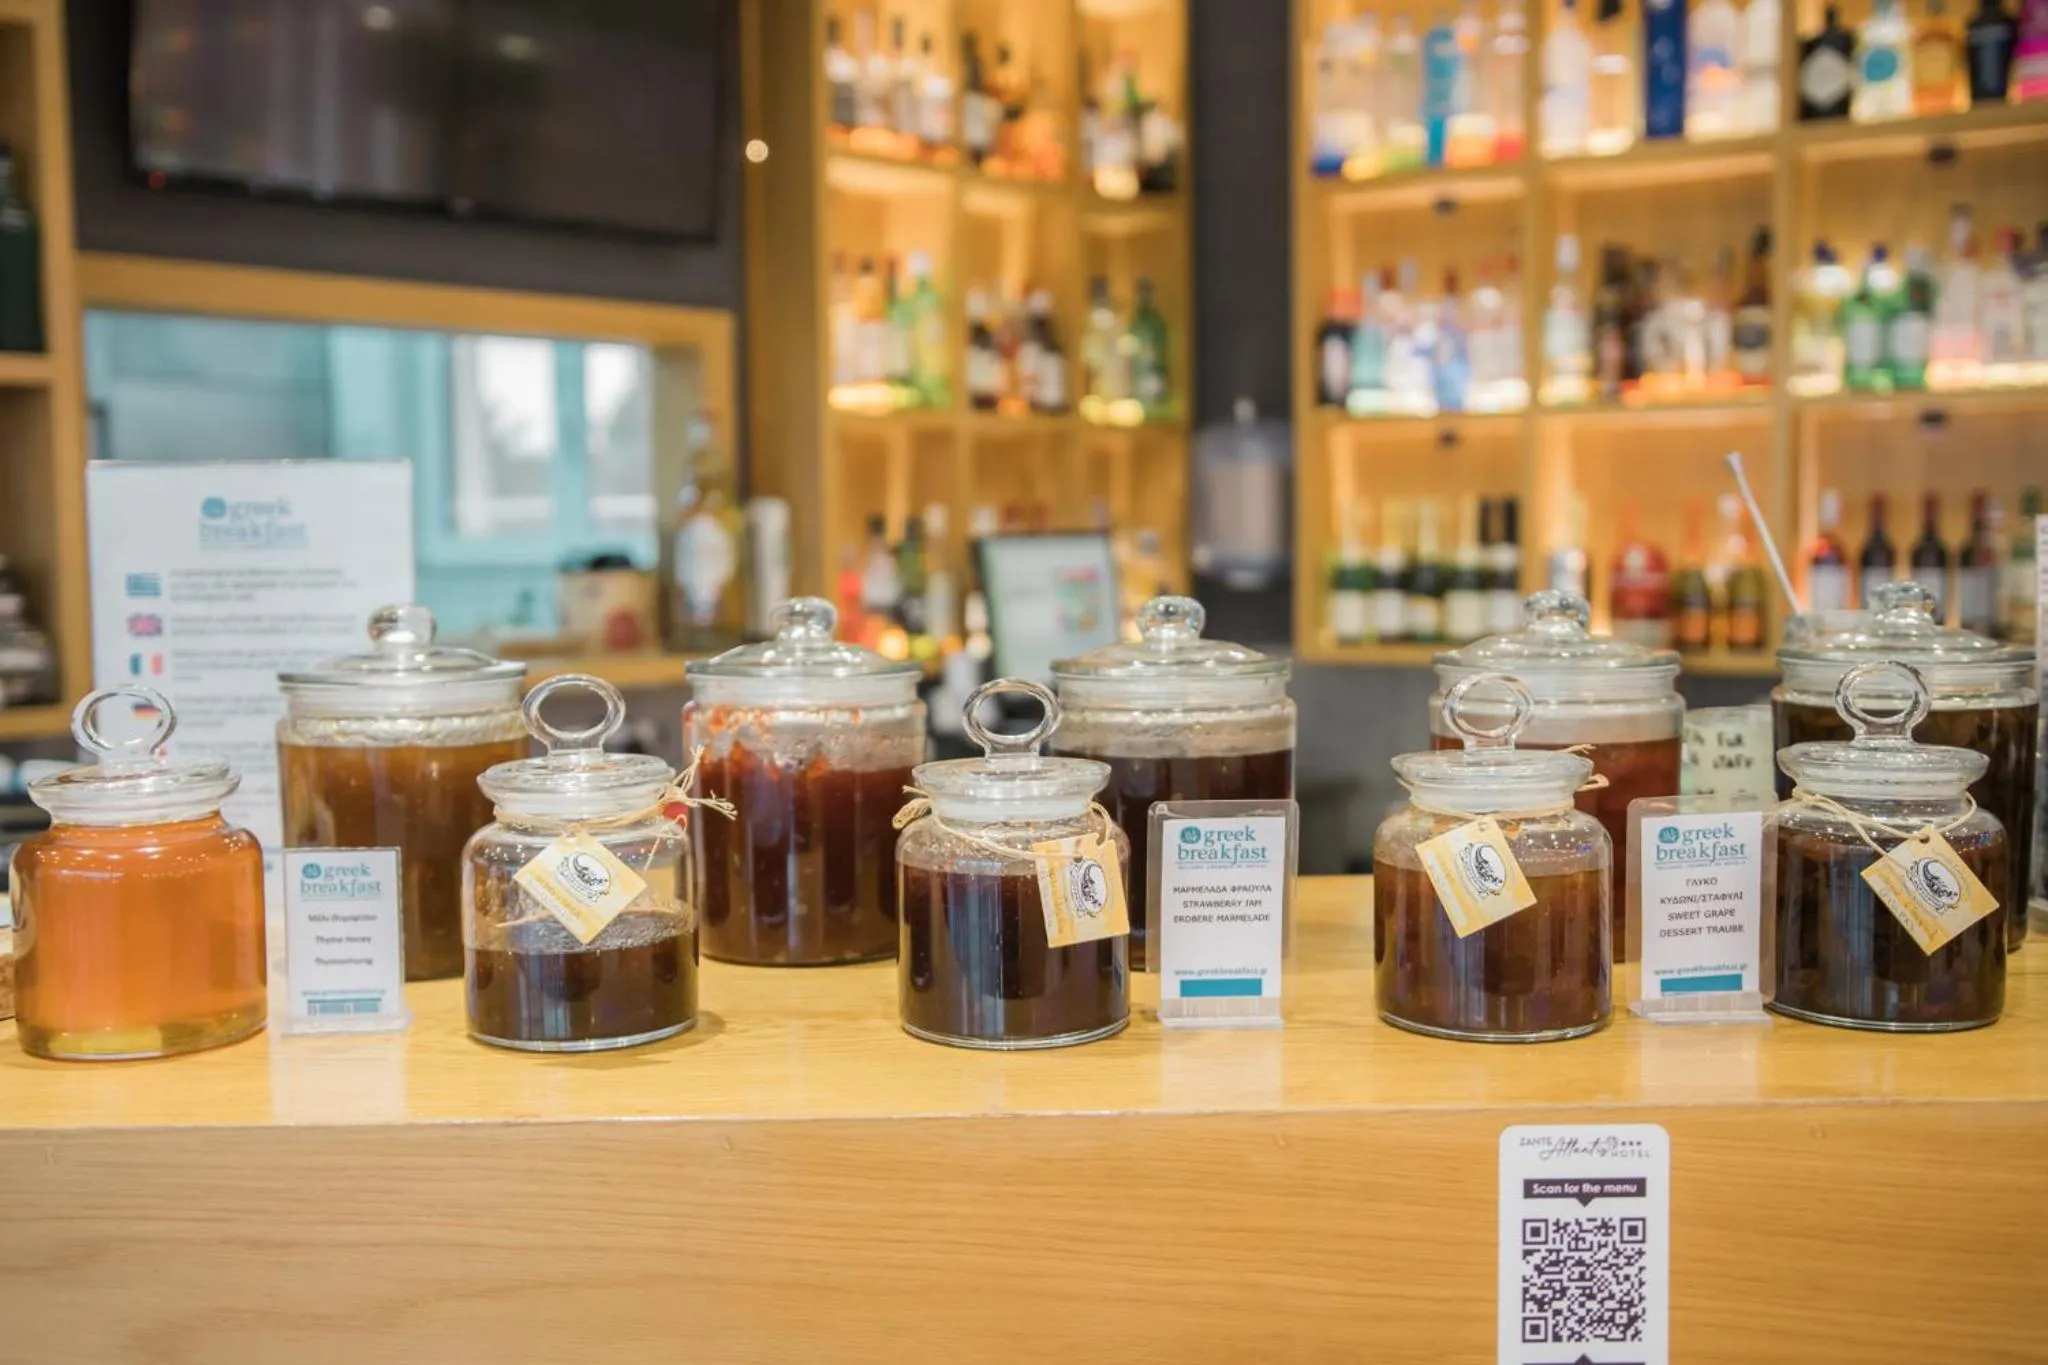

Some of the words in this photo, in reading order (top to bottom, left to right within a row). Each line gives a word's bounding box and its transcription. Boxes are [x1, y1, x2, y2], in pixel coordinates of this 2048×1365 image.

[229, 496, 293, 522] greek
[199, 520, 306, 547] breakfast
[1203, 824, 1257, 848] greek
[1681, 822, 1736, 846] greek
[1177, 842, 1267, 865] breakfast
[1656, 841, 1746, 864] breakfast
[324, 862, 371, 881] greek
[300, 879, 381, 897] breakfast
[1685, 877, 1719, 887] ΓΛΥΚΟ
[1182, 900, 1242, 909] STRAWBERRY
[1216, 913, 1270, 922] MARMELADE
[1667, 911, 1700, 921] SWEET
[1703, 908, 1736, 918] GRAPE
[1659, 927, 1703, 938] DESSERT
[1705, 924, 1744, 935] TRAUBE
[1519, 1136, 1552, 1147] ZANTE
[1611, 1149, 1650, 1158] HOTEL
[1532, 1183, 1562, 1194] Scan
[1563, 1182, 1580, 1193] for
[1581, 1182, 1602, 1193] the
[1603, 1182, 1638, 1194] menu
